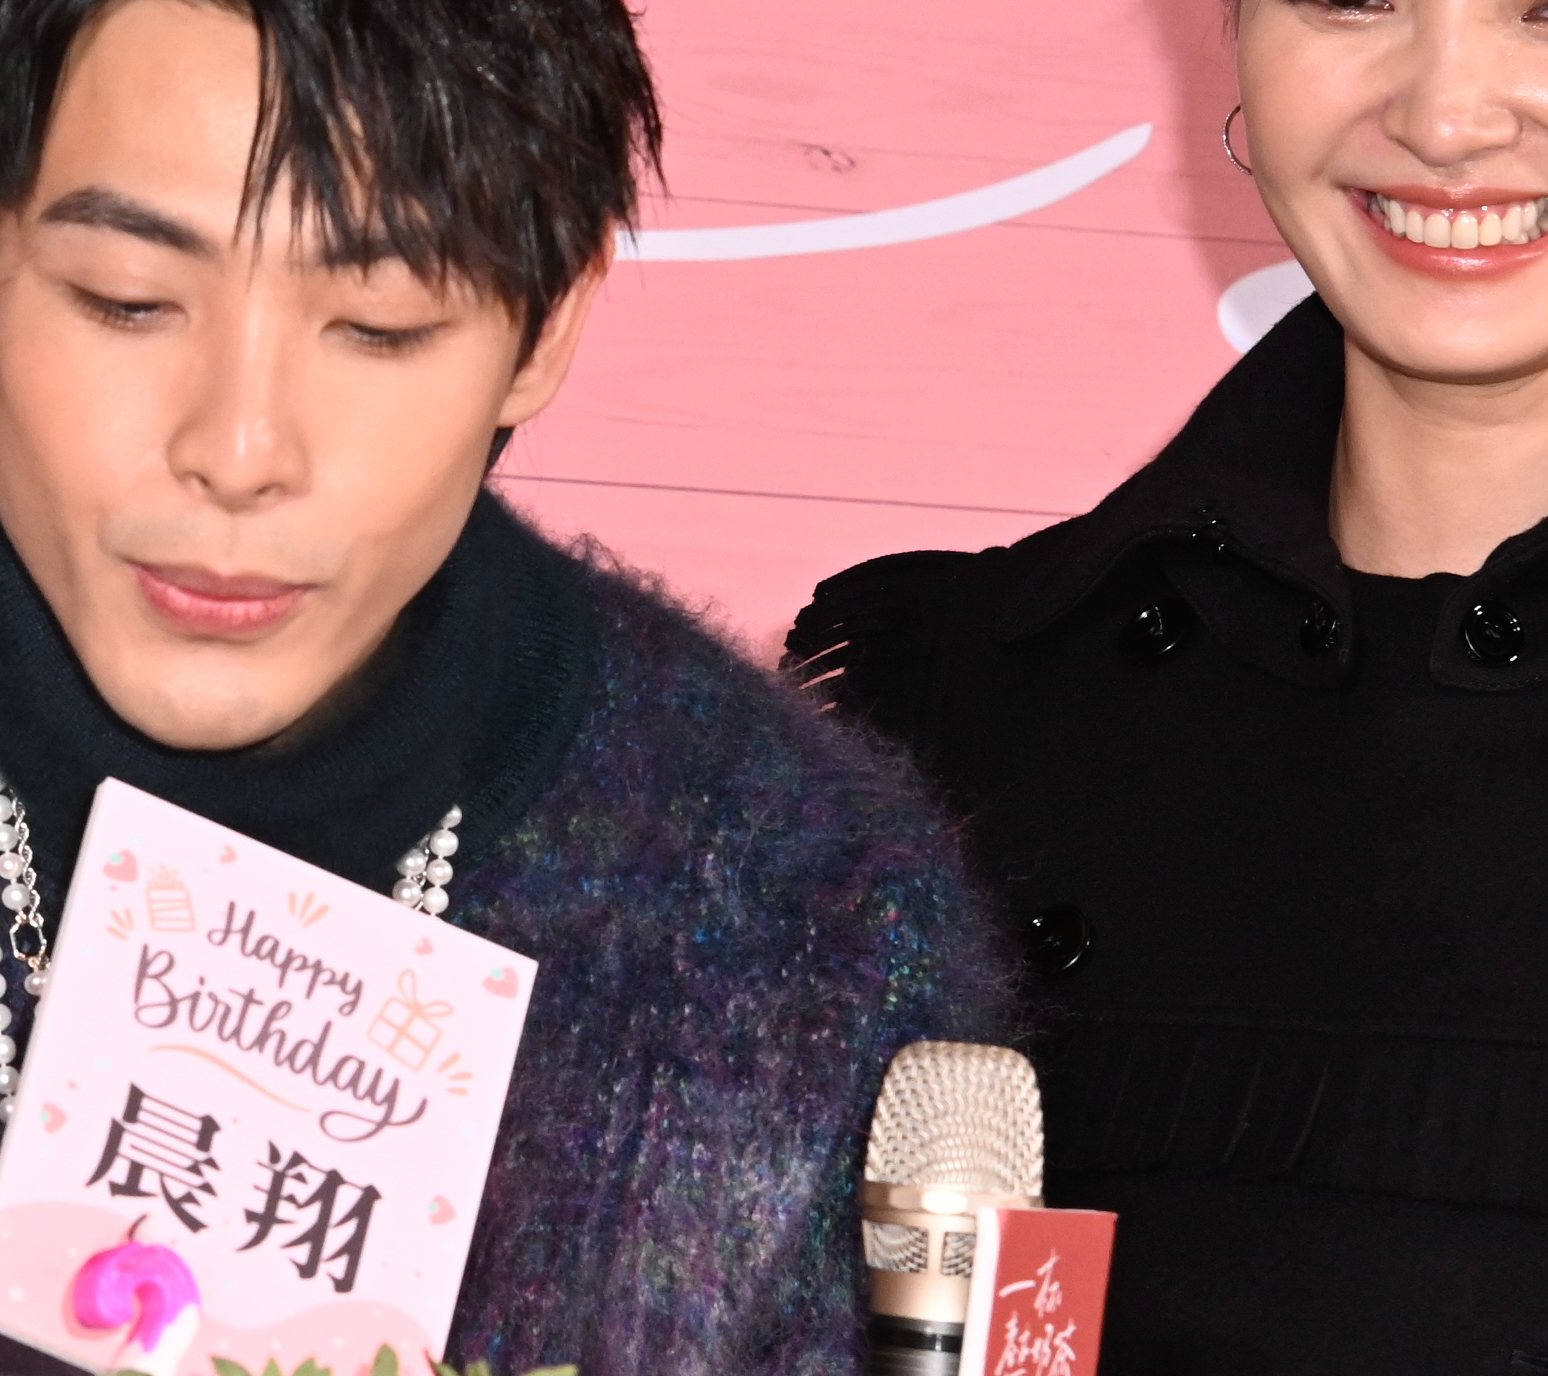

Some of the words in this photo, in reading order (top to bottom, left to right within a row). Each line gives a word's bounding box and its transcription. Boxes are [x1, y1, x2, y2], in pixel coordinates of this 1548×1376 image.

[133, 942, 429, 1143] Birthday
[206, 899, 365, 1017] Happy
[84, 1081, 383, 1294] 晨翔
